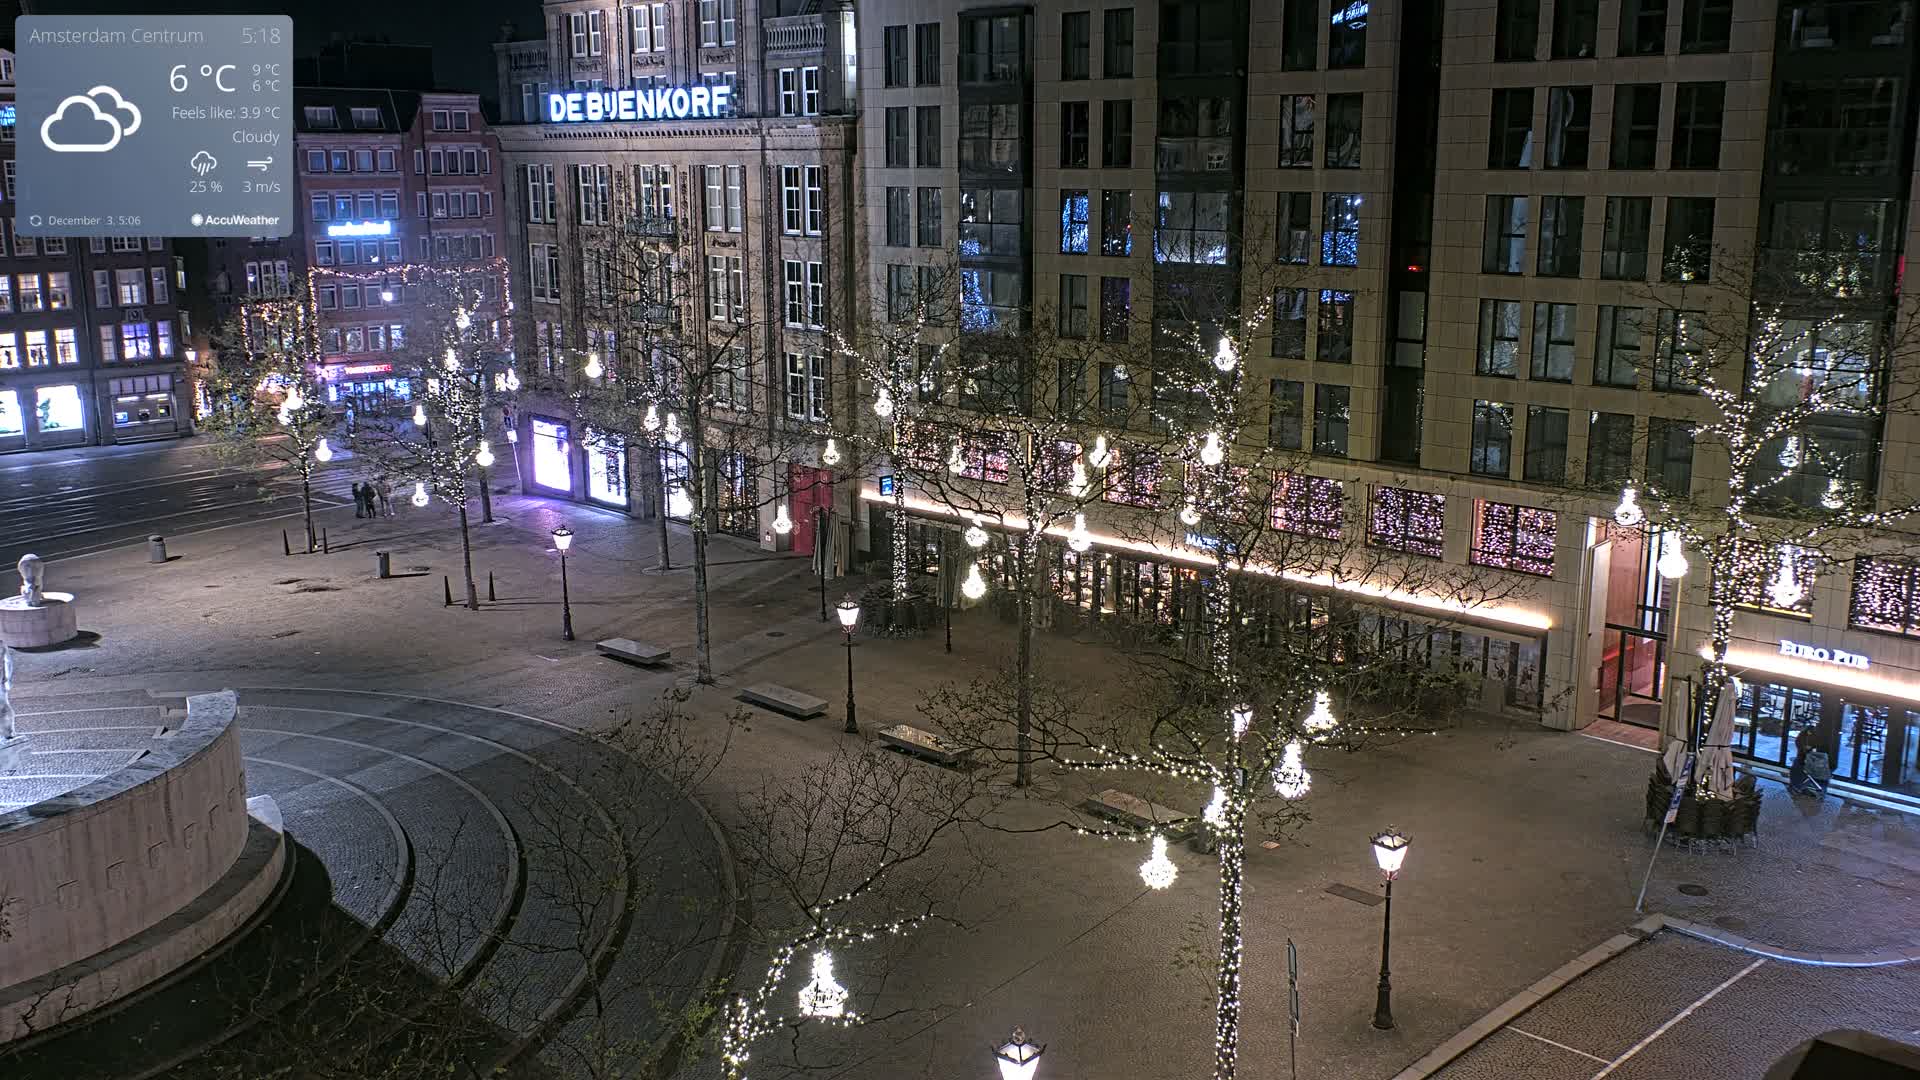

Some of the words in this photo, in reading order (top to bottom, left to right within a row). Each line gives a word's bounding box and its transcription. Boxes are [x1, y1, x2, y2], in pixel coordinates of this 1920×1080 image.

[550, 93, 583, 122] DE
[586, 85, 731, 121] BIJENKORF
[1780, 640, 1830, 662] EURO
[1833, 649, 1871, 670] PUB
